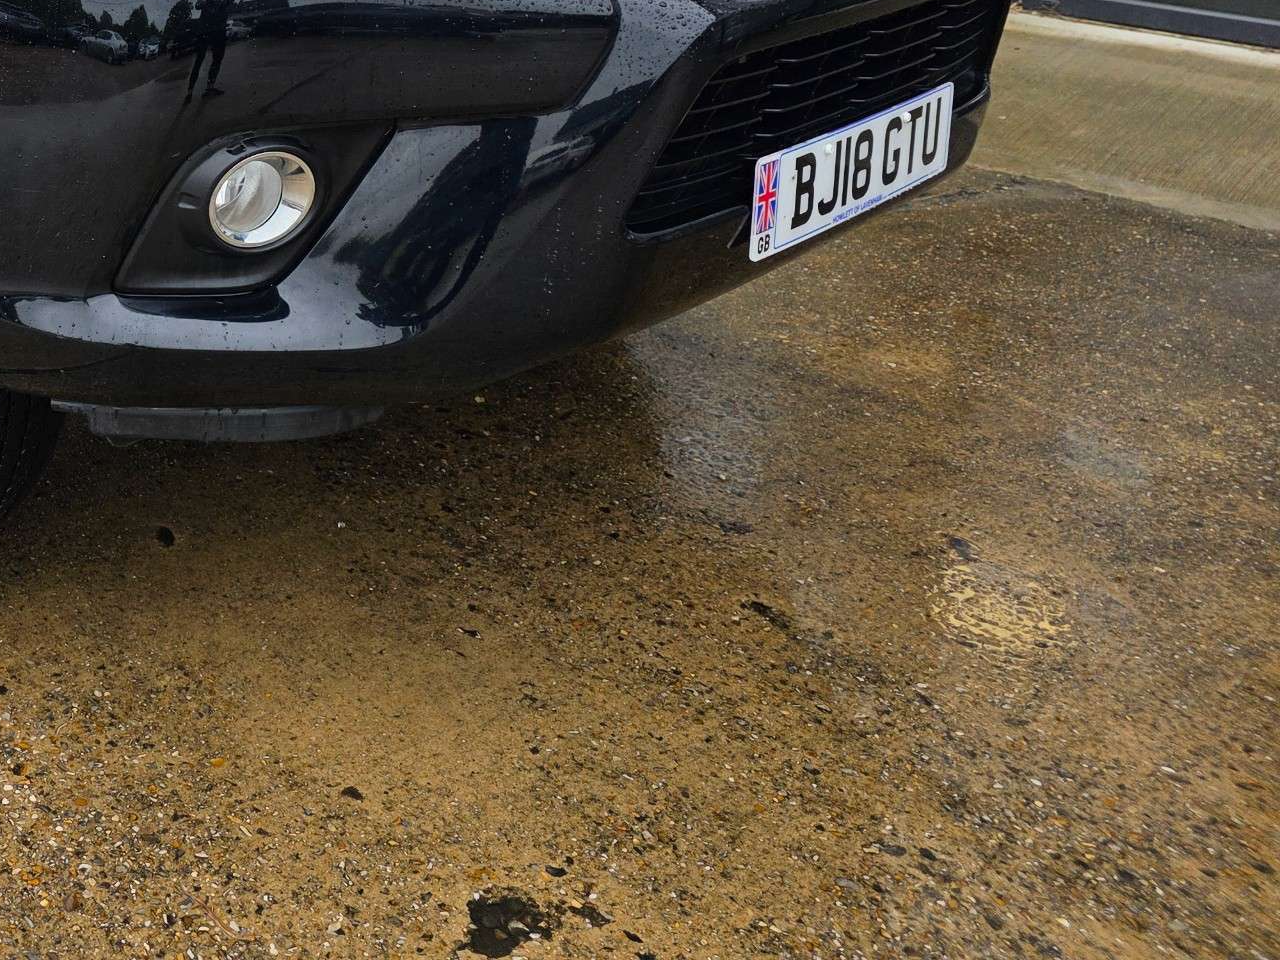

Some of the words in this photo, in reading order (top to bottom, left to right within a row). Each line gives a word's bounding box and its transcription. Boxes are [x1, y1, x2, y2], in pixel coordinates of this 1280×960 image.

[791, 128, 874, 229] BJ18
[882, 97, 942, 186] GTU
[757, 233, 771, 254] GB
